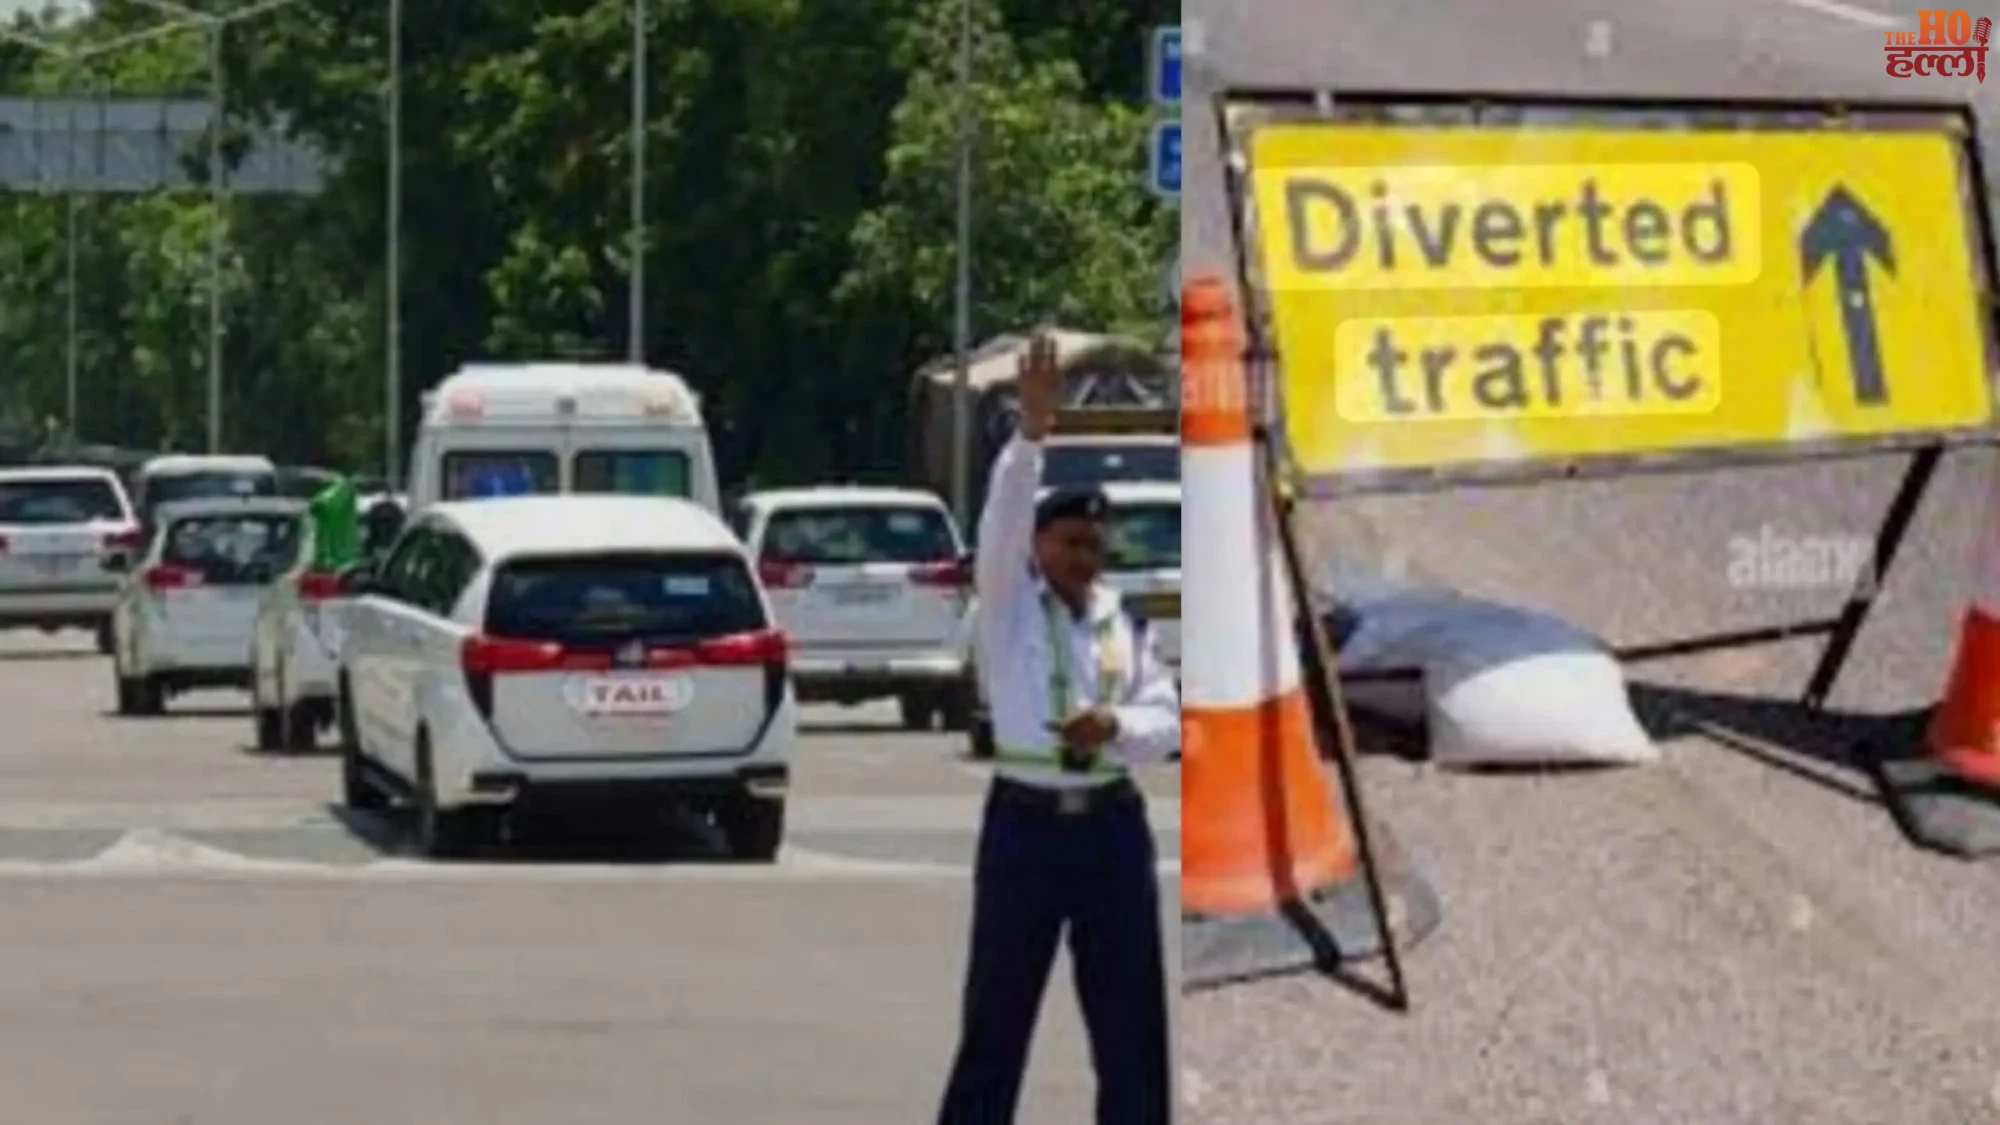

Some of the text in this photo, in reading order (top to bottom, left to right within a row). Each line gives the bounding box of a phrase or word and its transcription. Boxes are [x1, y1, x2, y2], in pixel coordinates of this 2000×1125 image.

[1284, 176, 1734, 273] Diverted
[1366, 315, 1704, 413] traffic
[592, 683, 668, 703] TAIL
